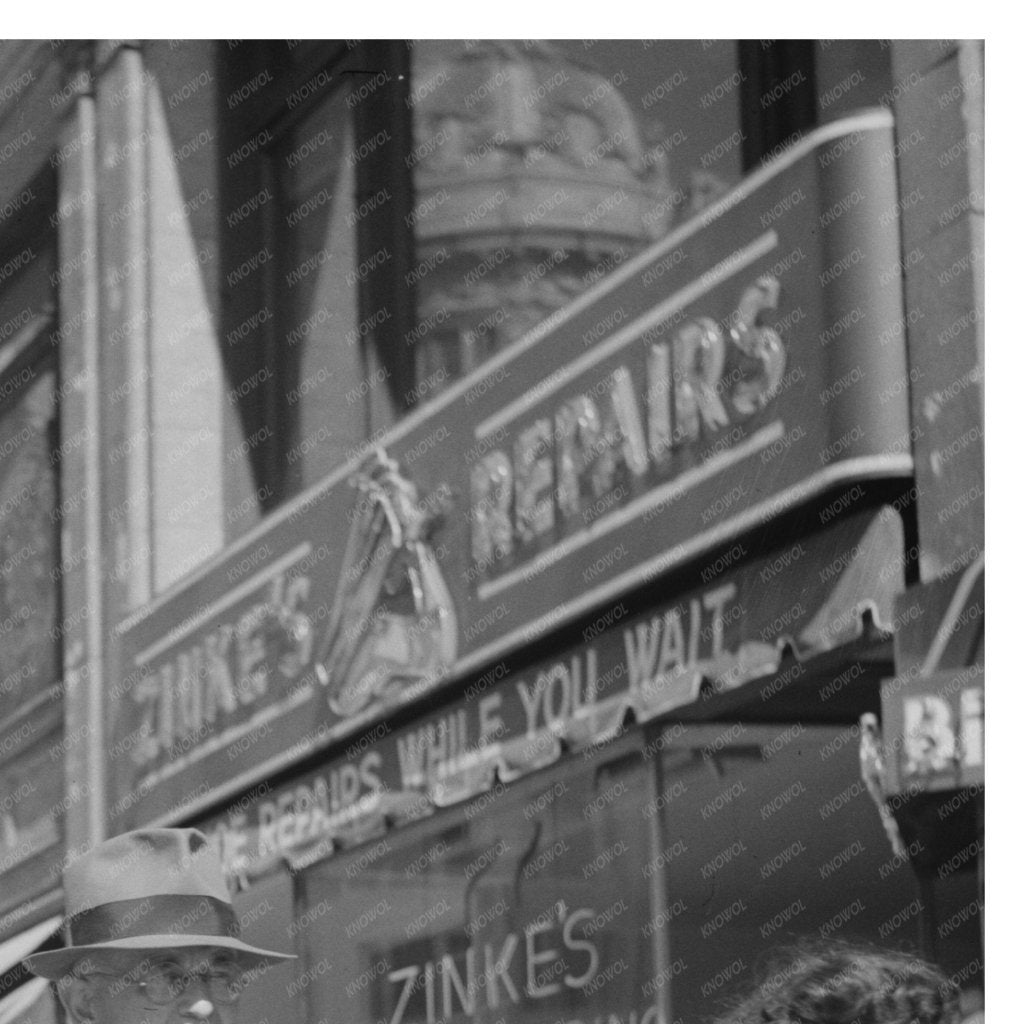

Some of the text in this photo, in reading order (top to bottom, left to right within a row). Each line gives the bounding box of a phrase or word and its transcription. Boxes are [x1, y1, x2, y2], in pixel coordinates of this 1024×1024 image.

[132, 276, 785, 764] ZINKE'S REPAIRS
[397, 693, 502, 786] WHILE
[517, 649, 596, 739] YOU
[624, 582, 736, 690] WAIT
